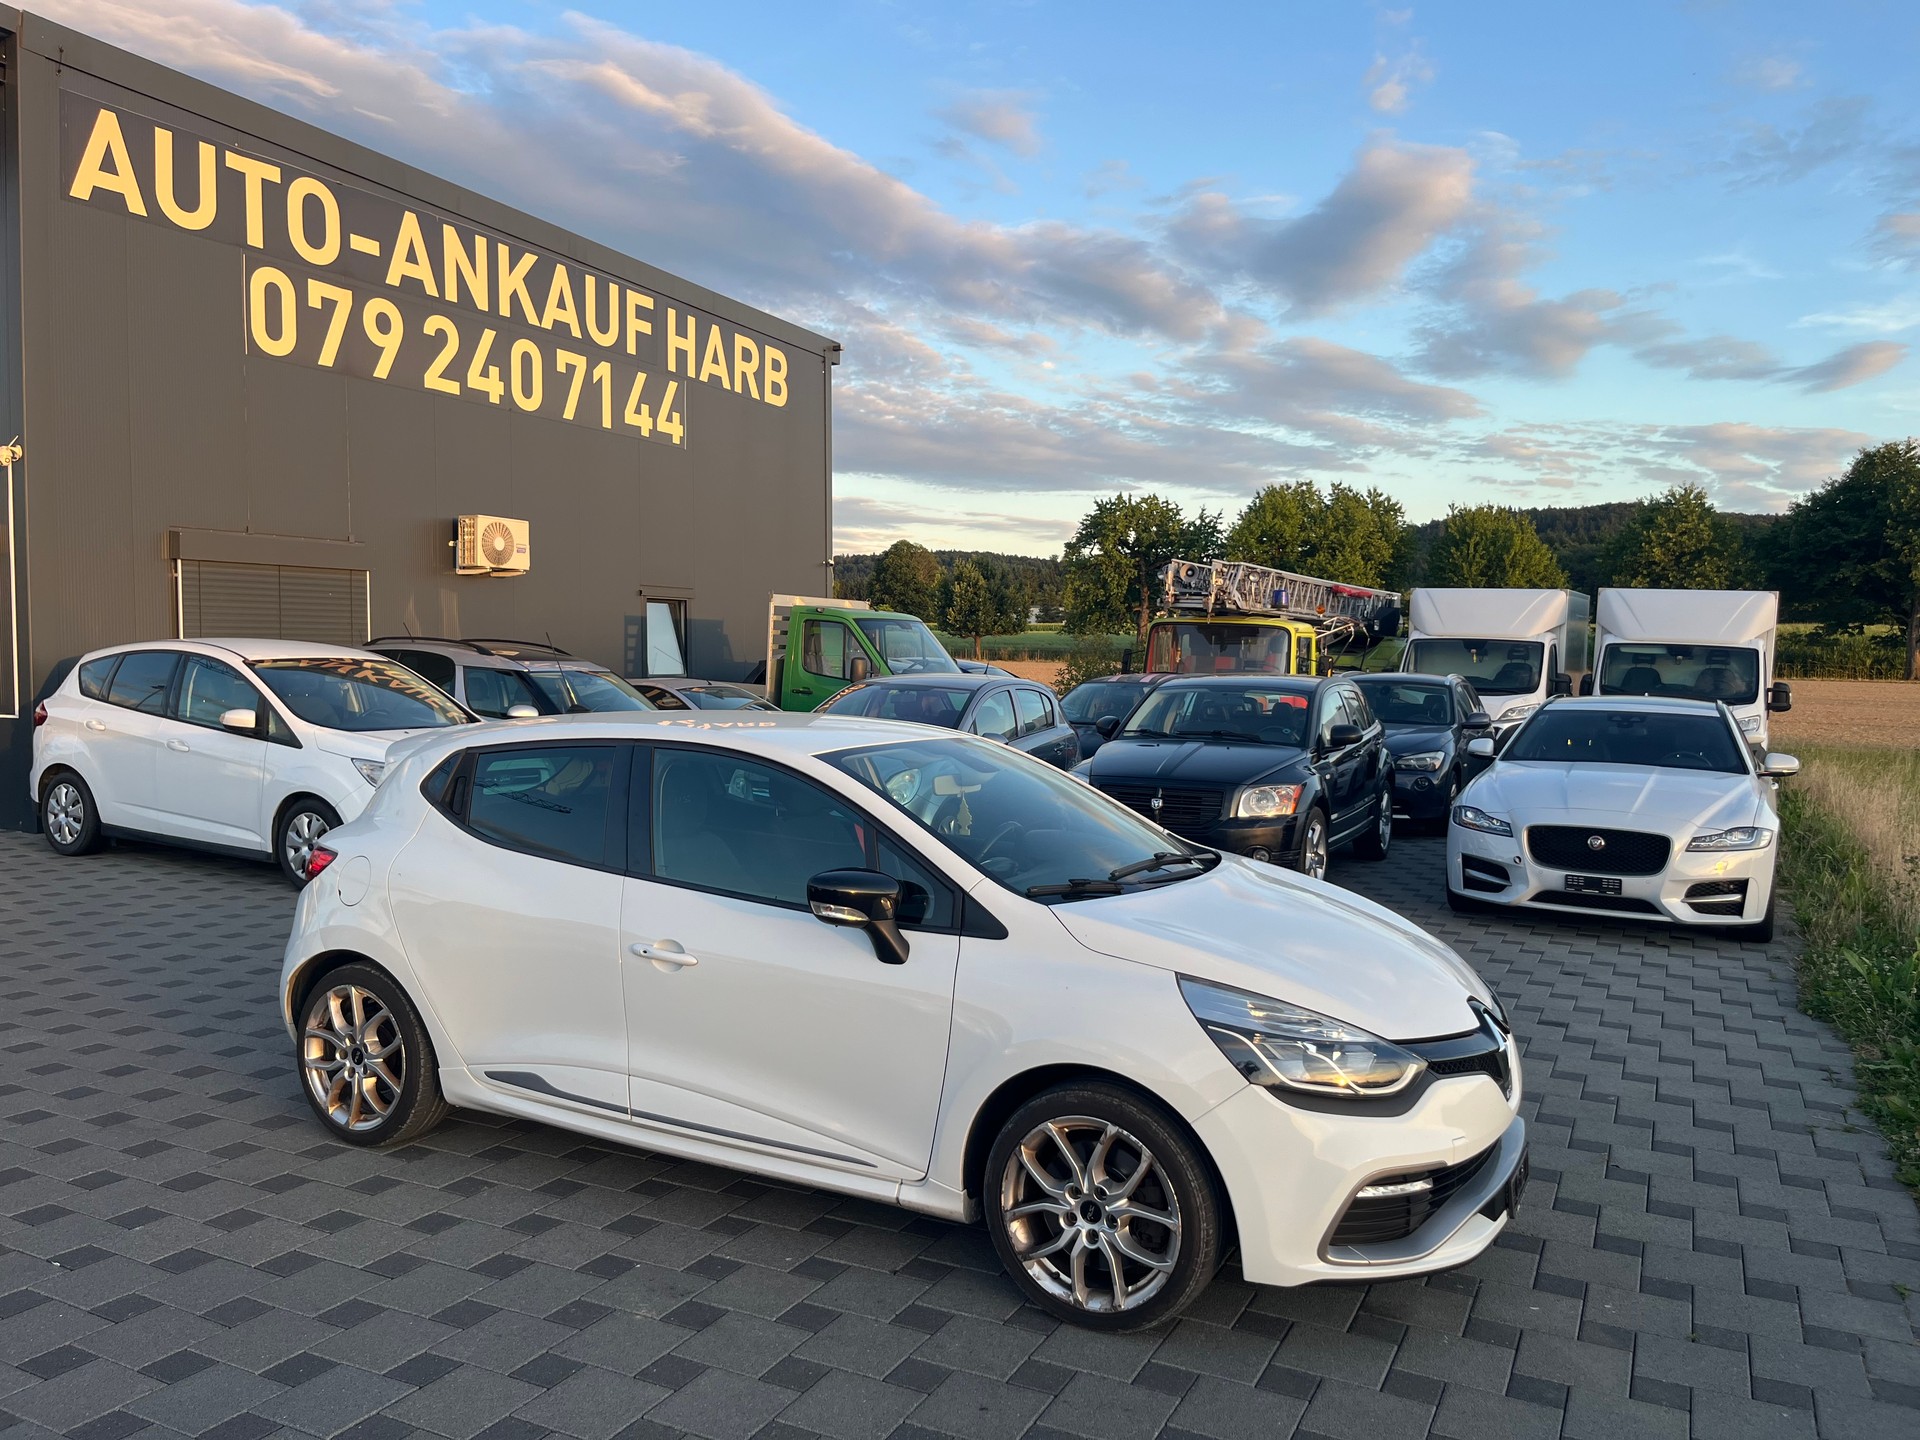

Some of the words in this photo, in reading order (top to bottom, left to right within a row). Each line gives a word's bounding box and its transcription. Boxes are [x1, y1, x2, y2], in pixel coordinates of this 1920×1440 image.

[68, 108, 655, 357] AUTO-ANKAUF
[667, 307, 789, 408] HARB
[249, 266, 404, 380] 079
[422, 314, 544, 412] 240
